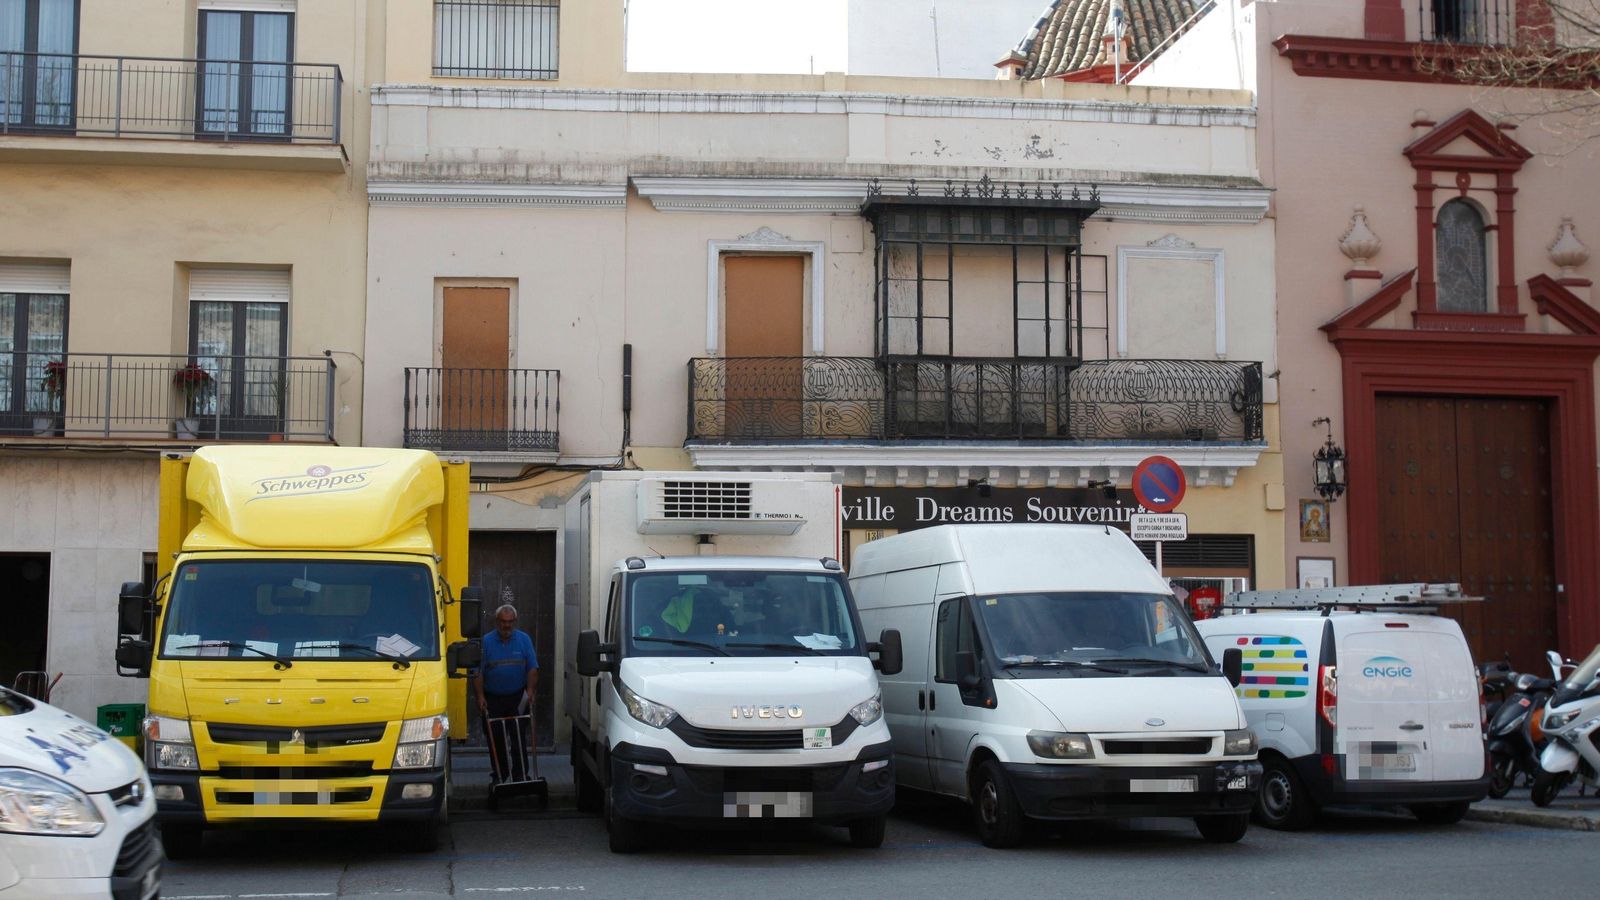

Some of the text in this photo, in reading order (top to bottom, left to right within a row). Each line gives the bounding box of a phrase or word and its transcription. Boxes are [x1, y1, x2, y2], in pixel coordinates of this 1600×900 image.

[256, 472, 368, 495] Schweppes
[915, 496, 1014, 522] Dreams
[731, 704, 803, 719] IVECO
